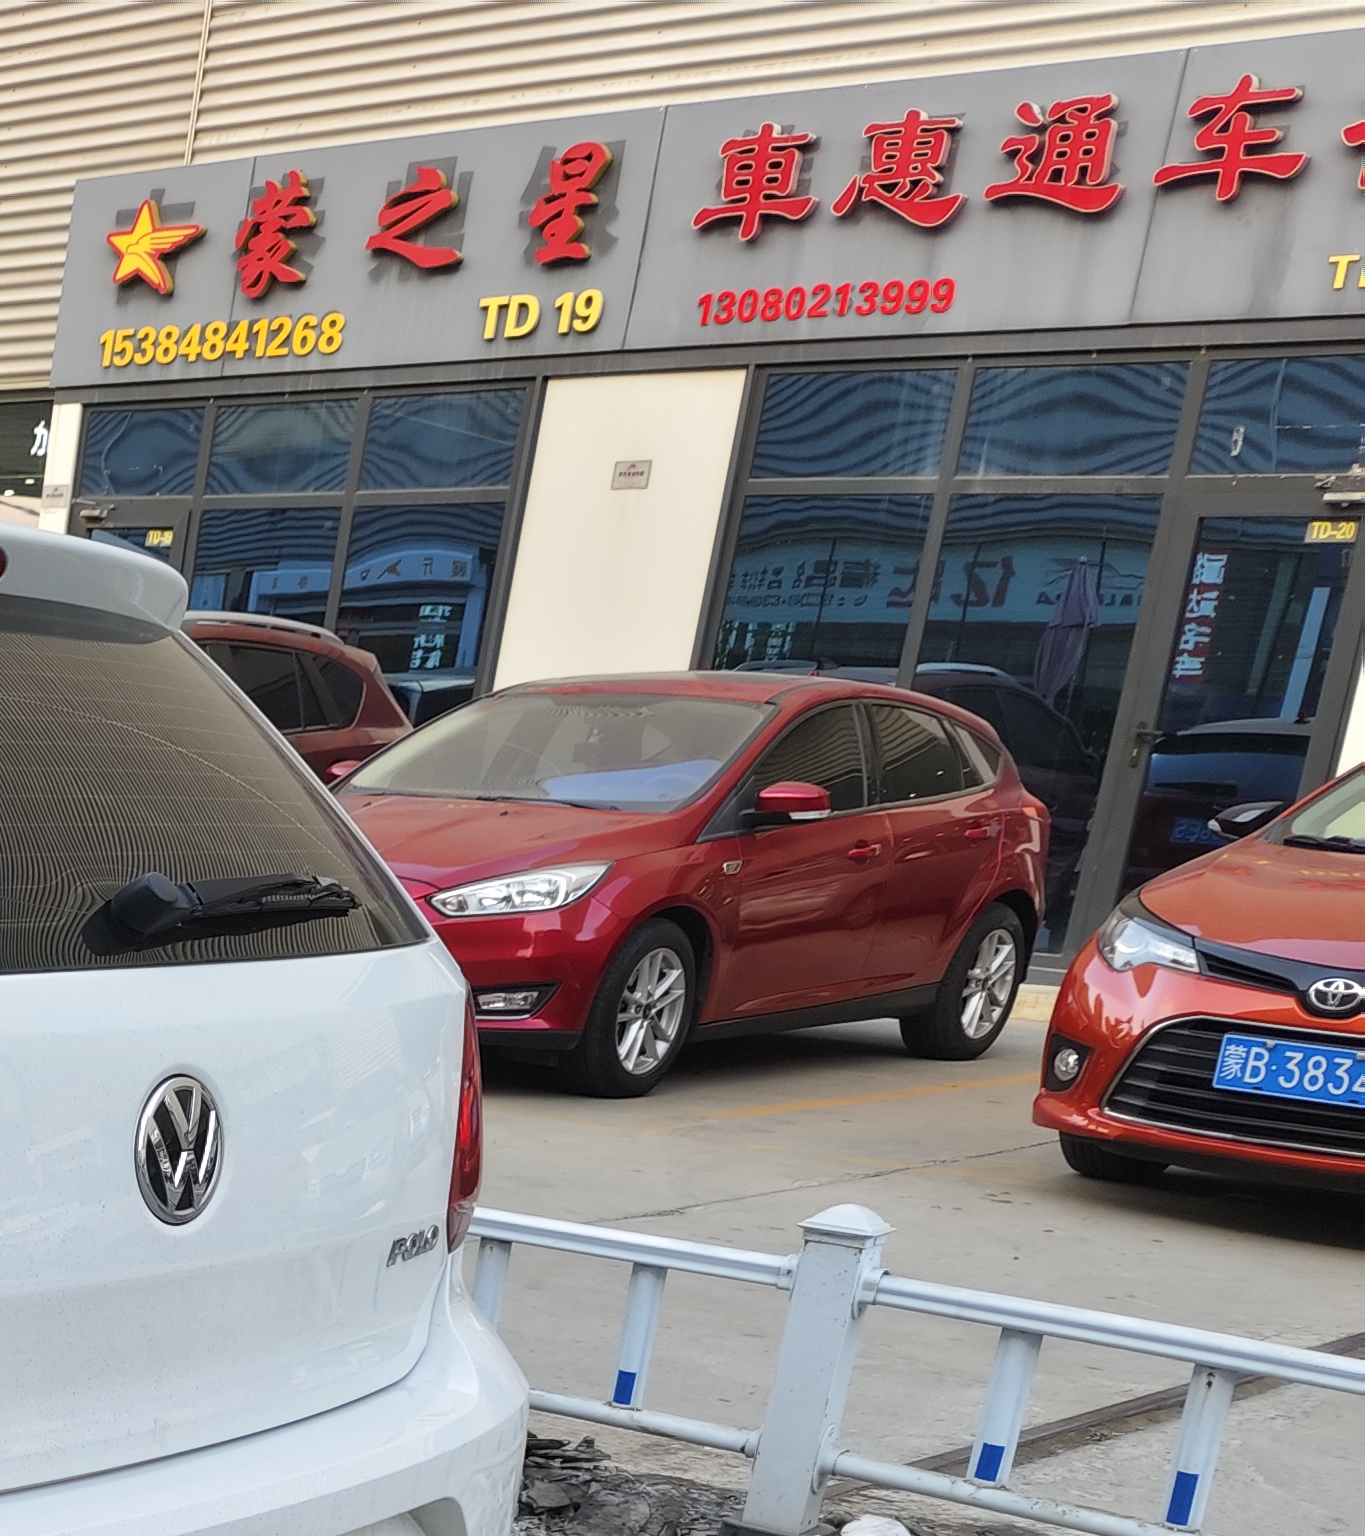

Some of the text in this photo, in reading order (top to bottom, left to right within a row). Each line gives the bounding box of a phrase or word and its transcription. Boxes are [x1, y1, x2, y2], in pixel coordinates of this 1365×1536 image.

[692, 72, 1365, 240] 車惠通车
[235, 141, 613, 299] 蒙之星
[1329, 254, 1365, 290] T
[478, 288, 604, 340] TD 19
[696, 278, 957, 326] 13080213999
[99, 311, 346, 368] 15384841268
[1311, 521, 1357, 540] TD-20
